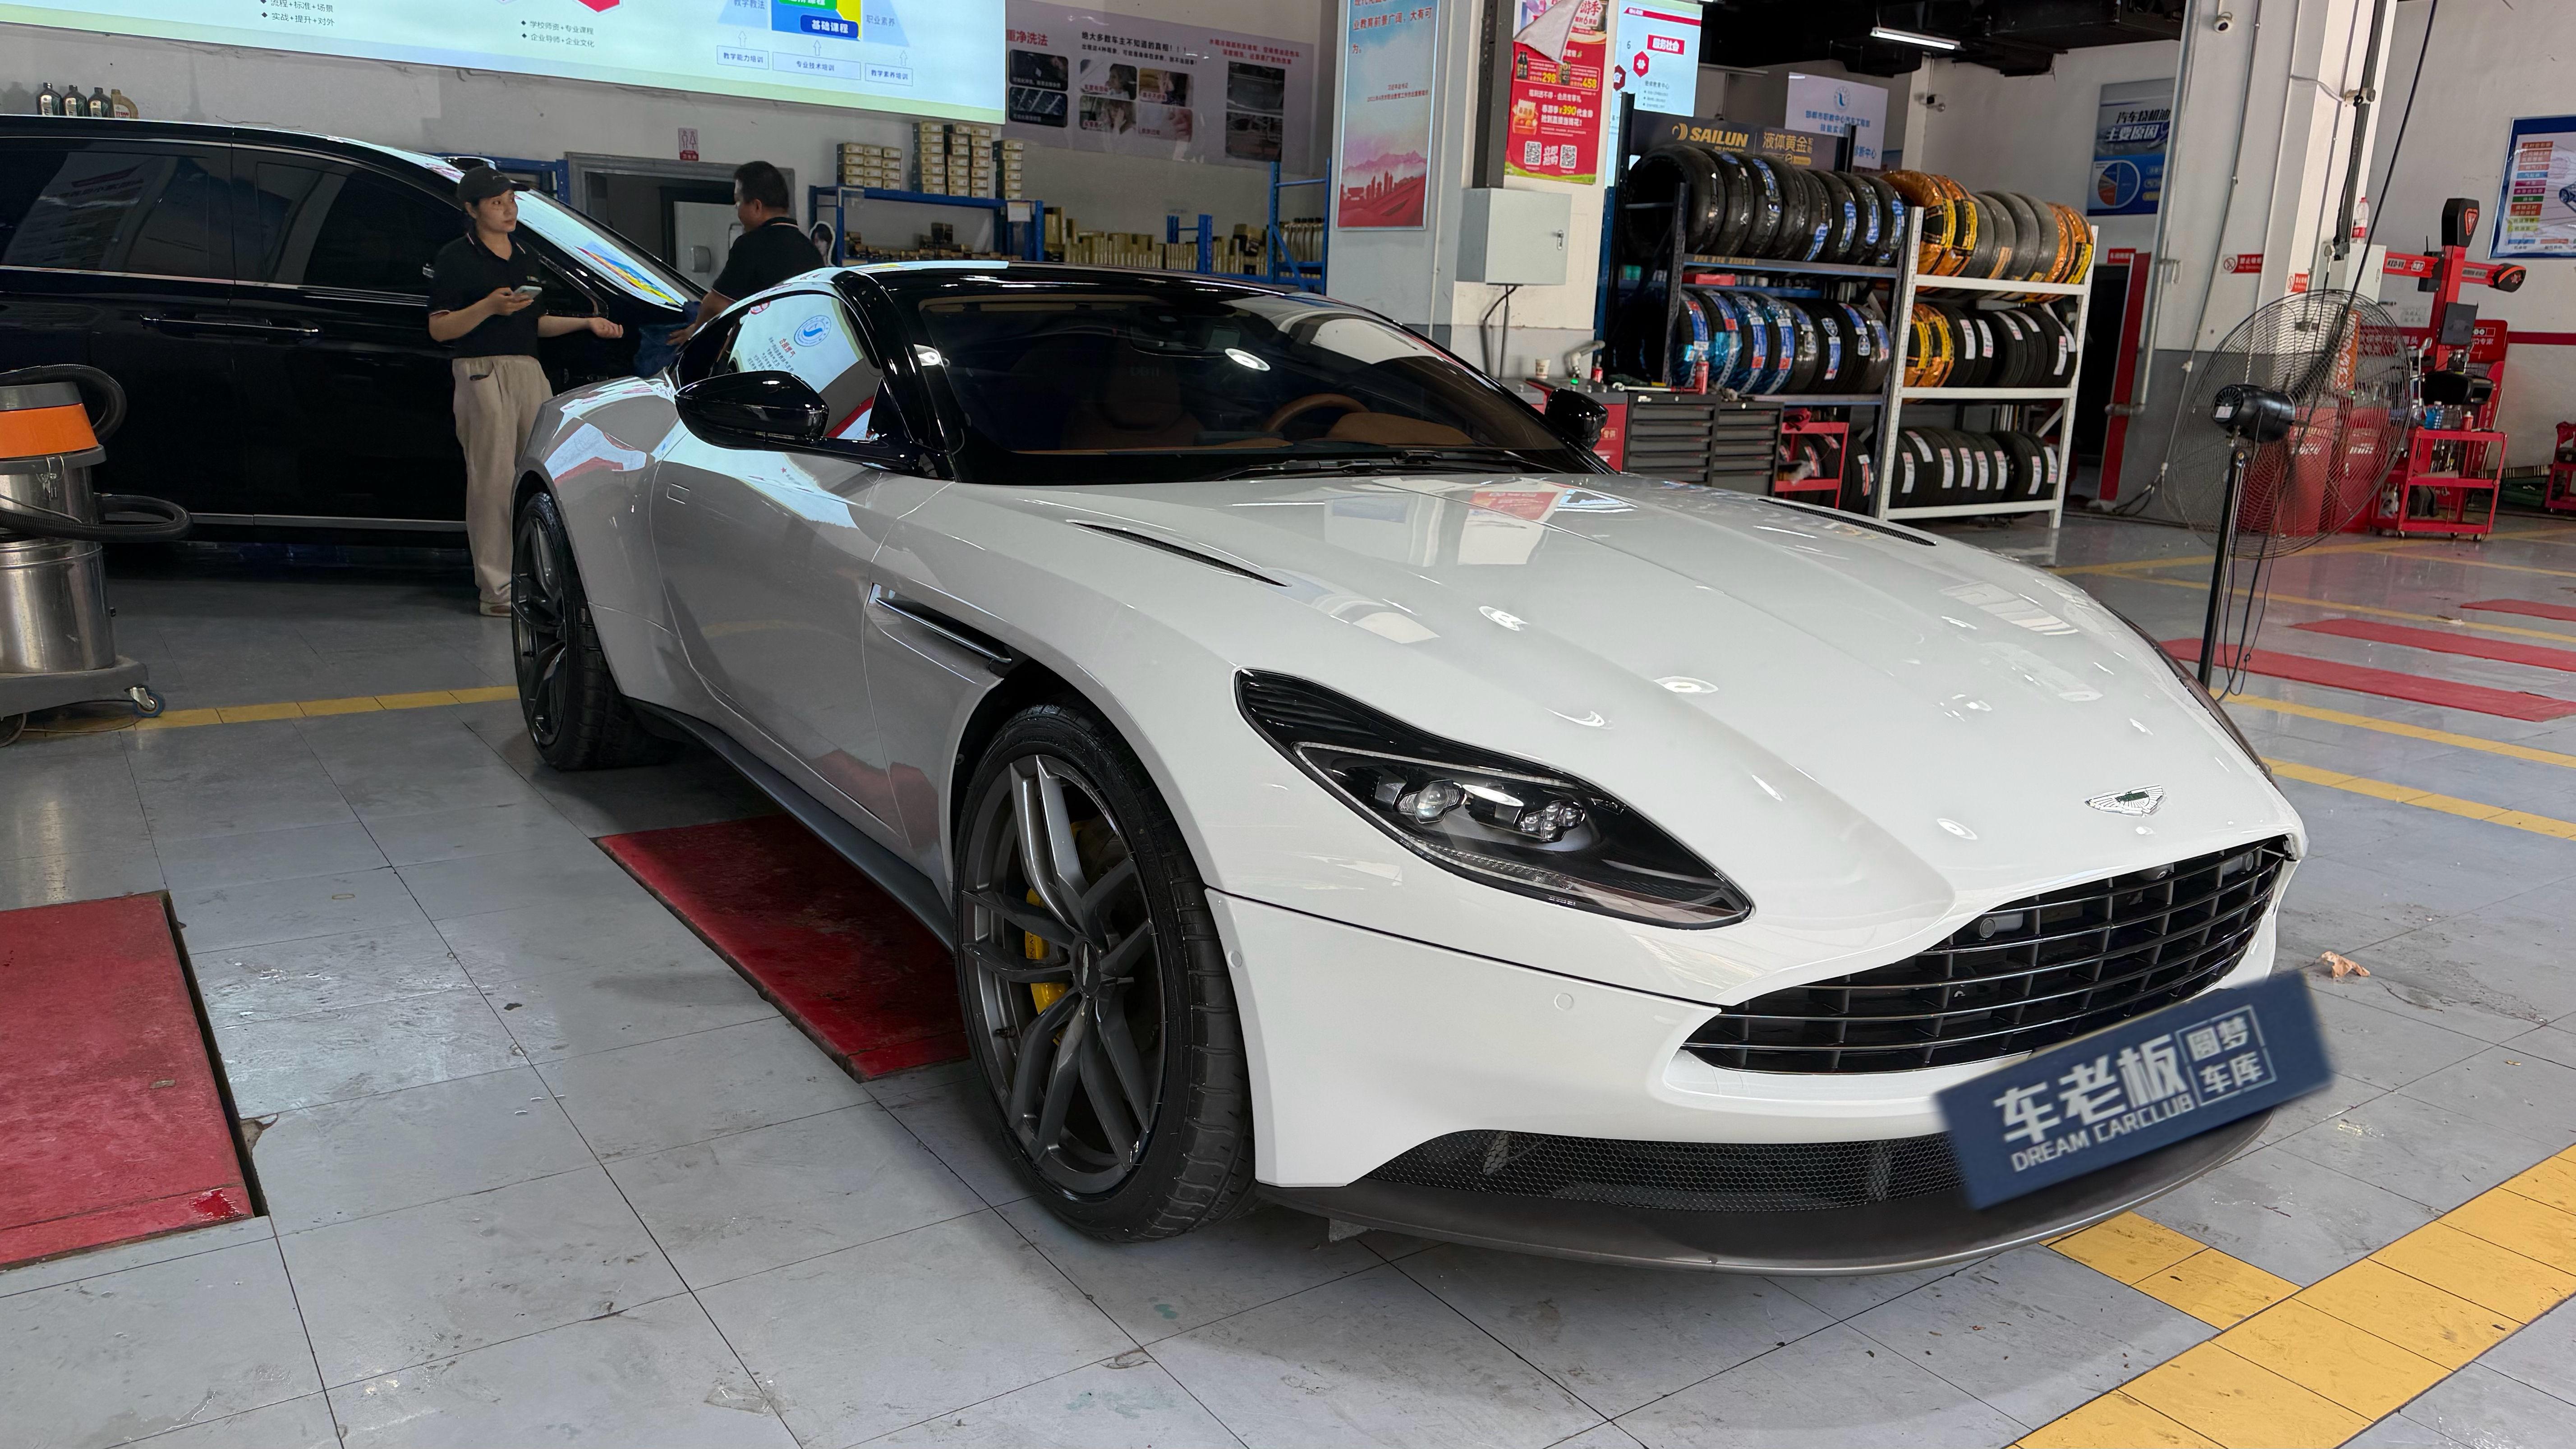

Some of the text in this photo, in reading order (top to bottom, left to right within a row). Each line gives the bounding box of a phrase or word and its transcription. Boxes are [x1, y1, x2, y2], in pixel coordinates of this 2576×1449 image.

[811, 19, 849, 34] 基础课程
[723, 52, 764, 64] 教学能力培训
[1542, 72, 1556, 84] 298
[1582, 77, 1597, 89] 458
[1689, 127, 1749, 147] SAILUN
[2107, 125, 2160, 142] 主要原因
[1762, 131, 1808, 153] 液体黄金
